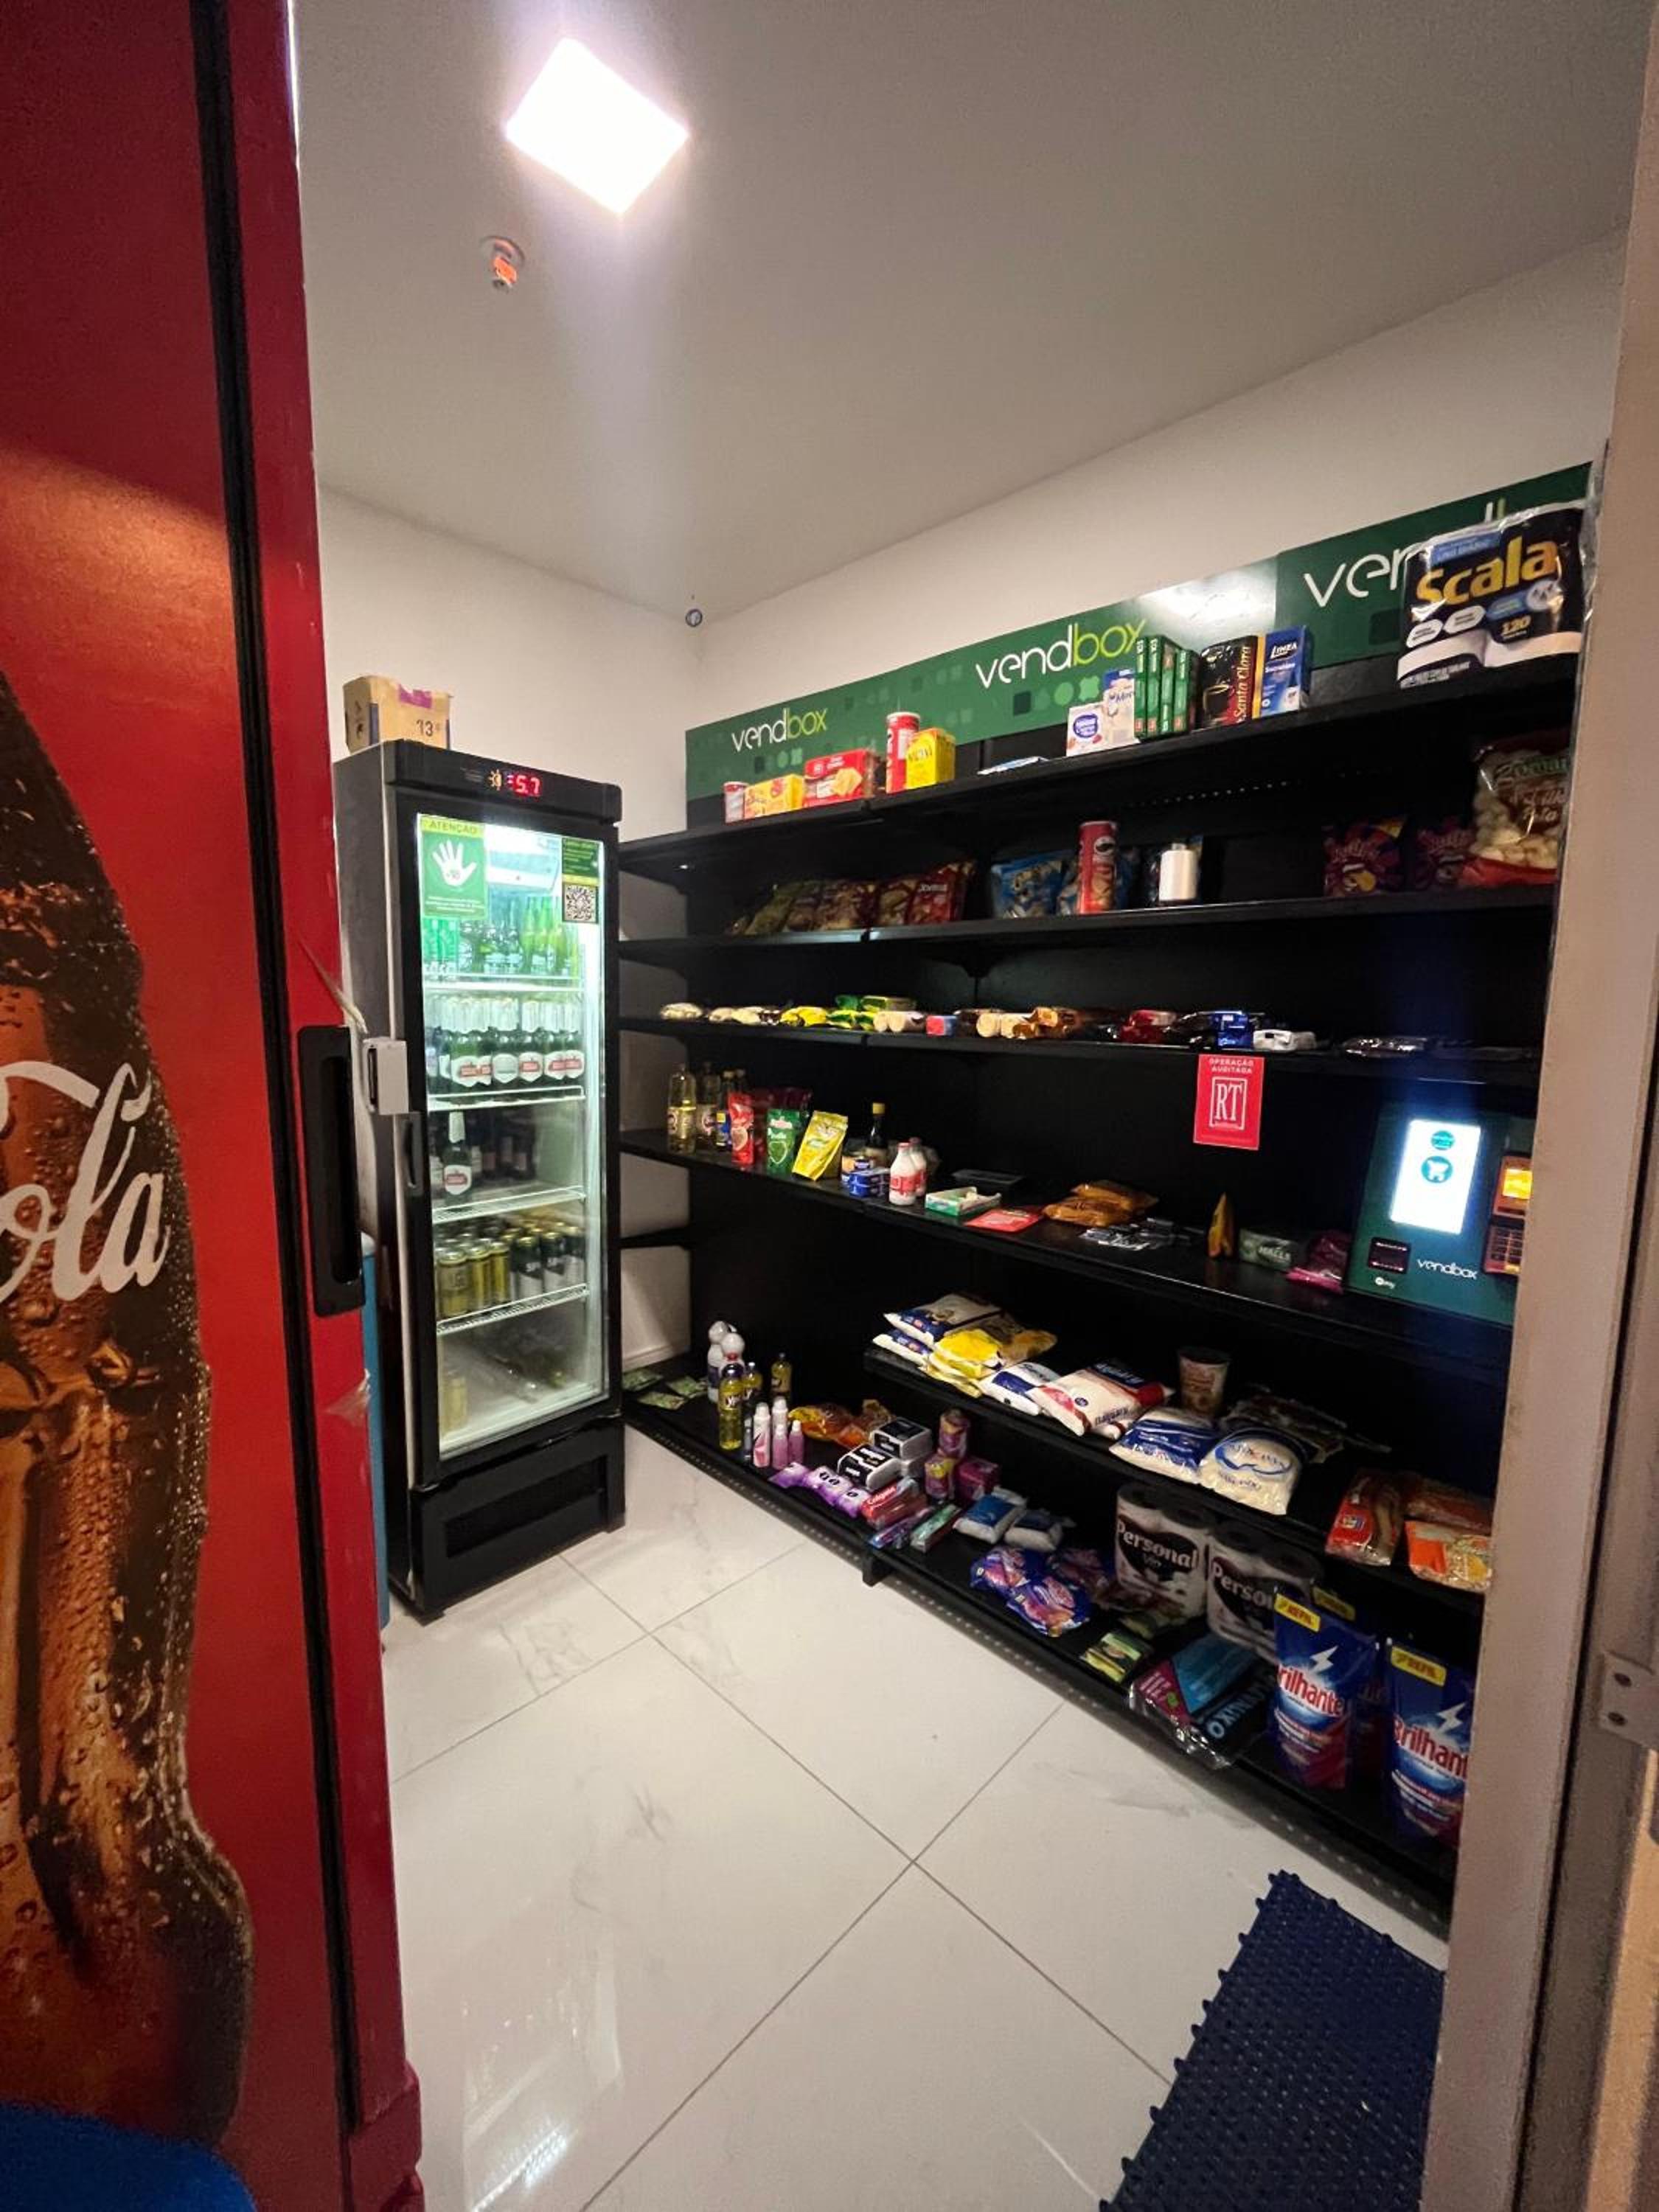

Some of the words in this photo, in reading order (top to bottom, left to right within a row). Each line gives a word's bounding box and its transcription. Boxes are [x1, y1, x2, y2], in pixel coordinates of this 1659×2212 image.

[975, 619, 1147, 689] vendbox
[1234, 683, 1248, 718] Santa
[731, 708, 828, 752] vendbox
[1209, 1057, 1254, 1067] OPERAÇÃO
[1215, 1082, 1242, 1121] RT
[1417, 1259, 1478, 1279] vendbox
[1116, 1519, 1198, 1569] Personal
